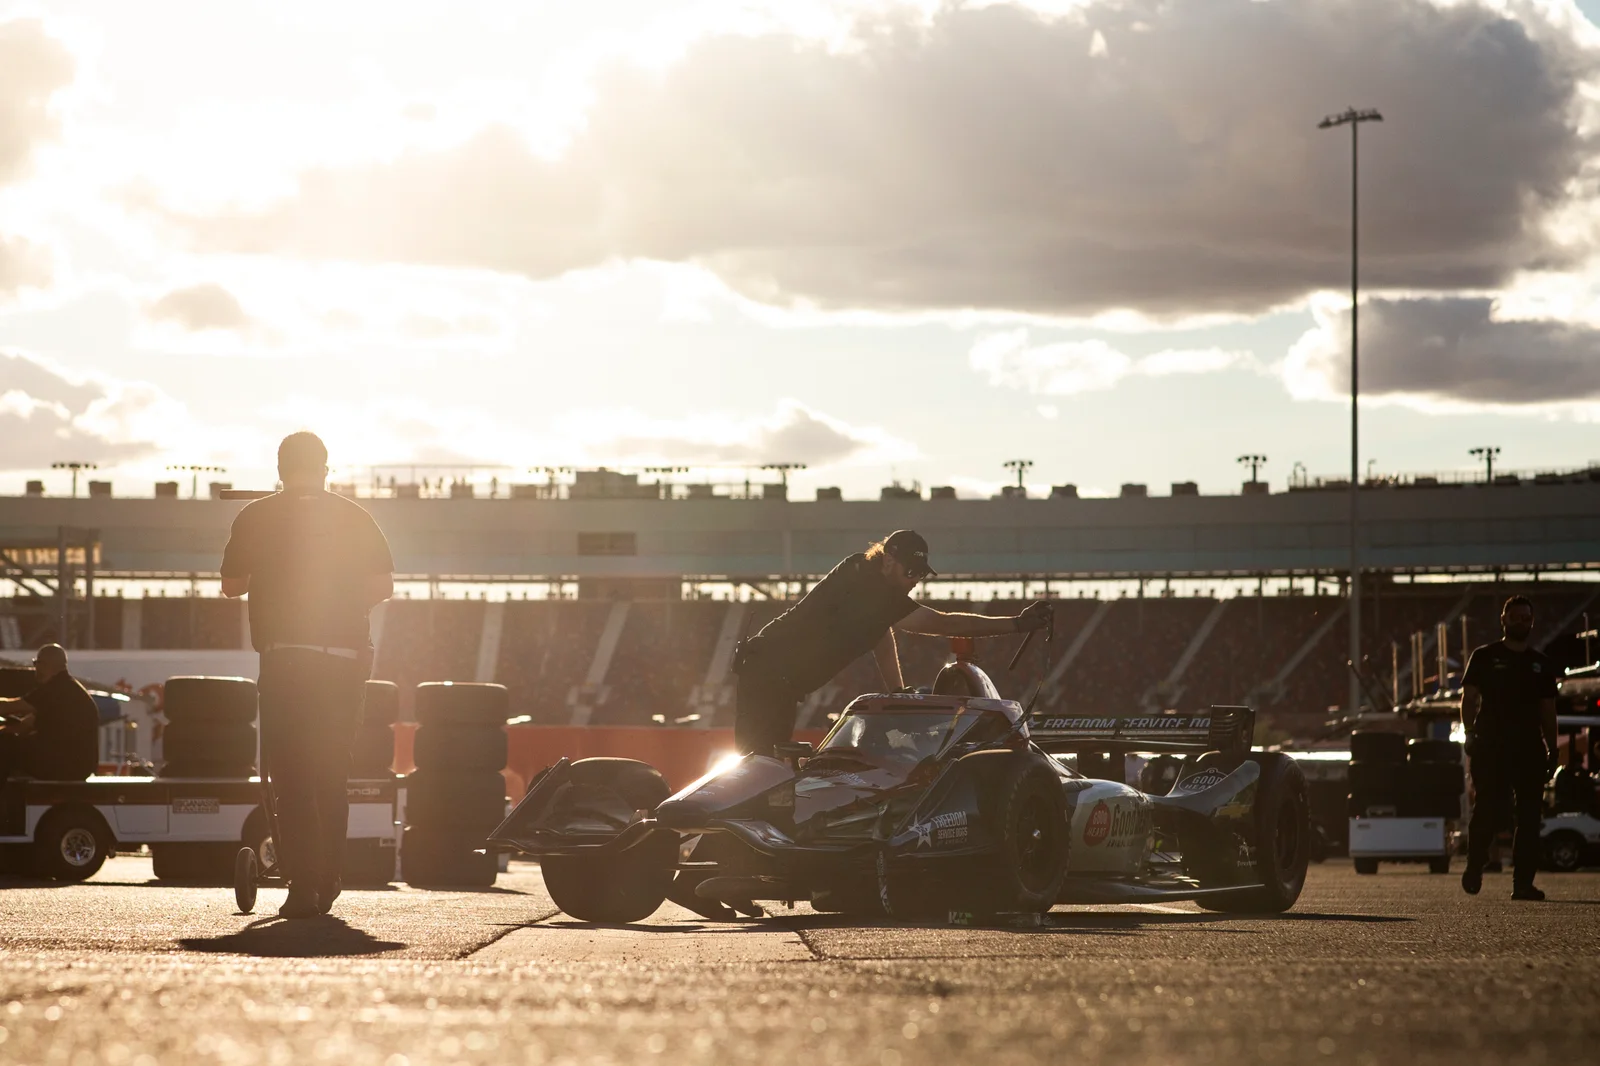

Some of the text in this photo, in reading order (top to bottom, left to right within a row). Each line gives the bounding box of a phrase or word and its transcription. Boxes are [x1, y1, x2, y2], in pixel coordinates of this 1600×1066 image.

[1043, 717, 1117, 729] FREEDOM
[1122, 717, 1187, 729] SERVICE
[1191, 775, 1223, 786] GOOD
[931, 810, 968, 829] FREEDOM
[1092, 810, 1108, 825] GOOD
[937, 828, 955, 840] SERVICE
[1087, 826, 1107, 838] HEART
